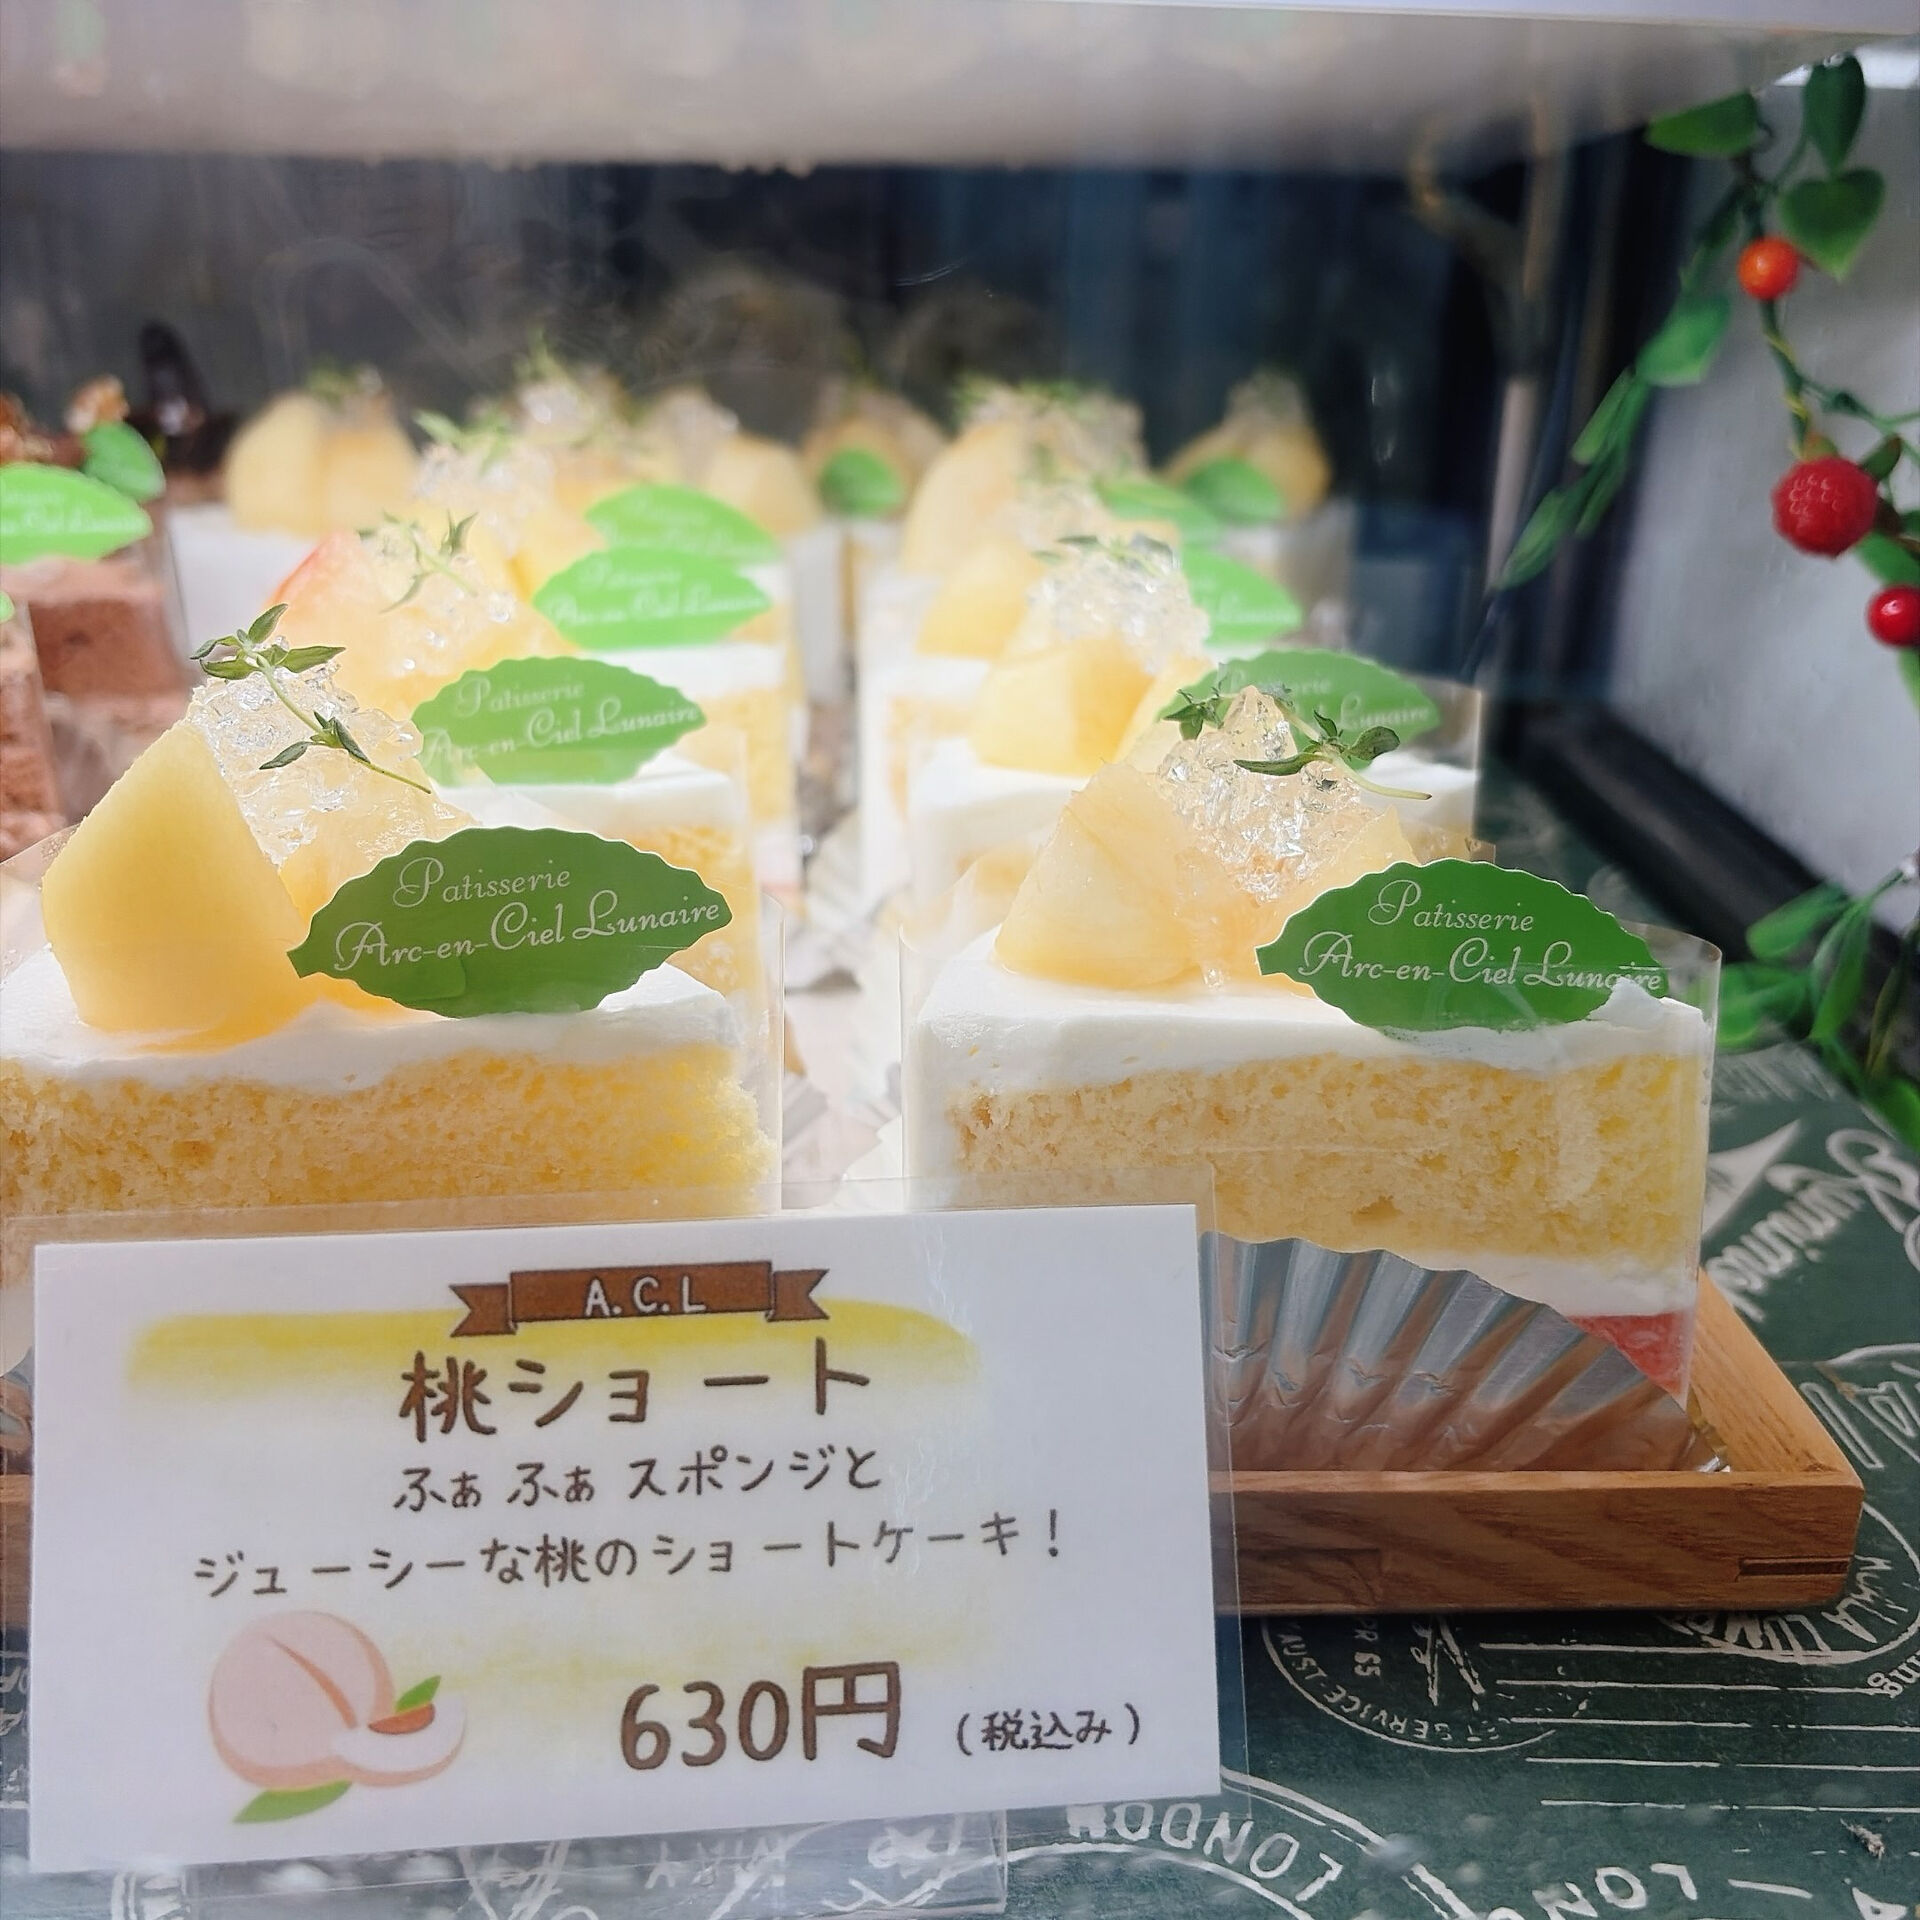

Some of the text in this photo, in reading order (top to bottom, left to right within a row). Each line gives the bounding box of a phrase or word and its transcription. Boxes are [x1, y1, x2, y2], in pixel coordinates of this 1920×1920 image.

[455, 675, 584, 717] Patisserie
[588, 697, 699, 737] Lunaire
[392, 855, 571, 908] Patisserie
[1367, 879, 1534, 932] Patisserie
[333, 889, 722, 972] Arc-en-Ciel Lunaire
[1298, 931, 1519, 988] Arc-en-Ciel
[398, 1338, 870, 1443] 桃ショート
[620, 1661, 902, 1770] 630円
[1323, 1684, 1453, 1741] SERVICE
[1488, 1862, 1698, 1920] LON
